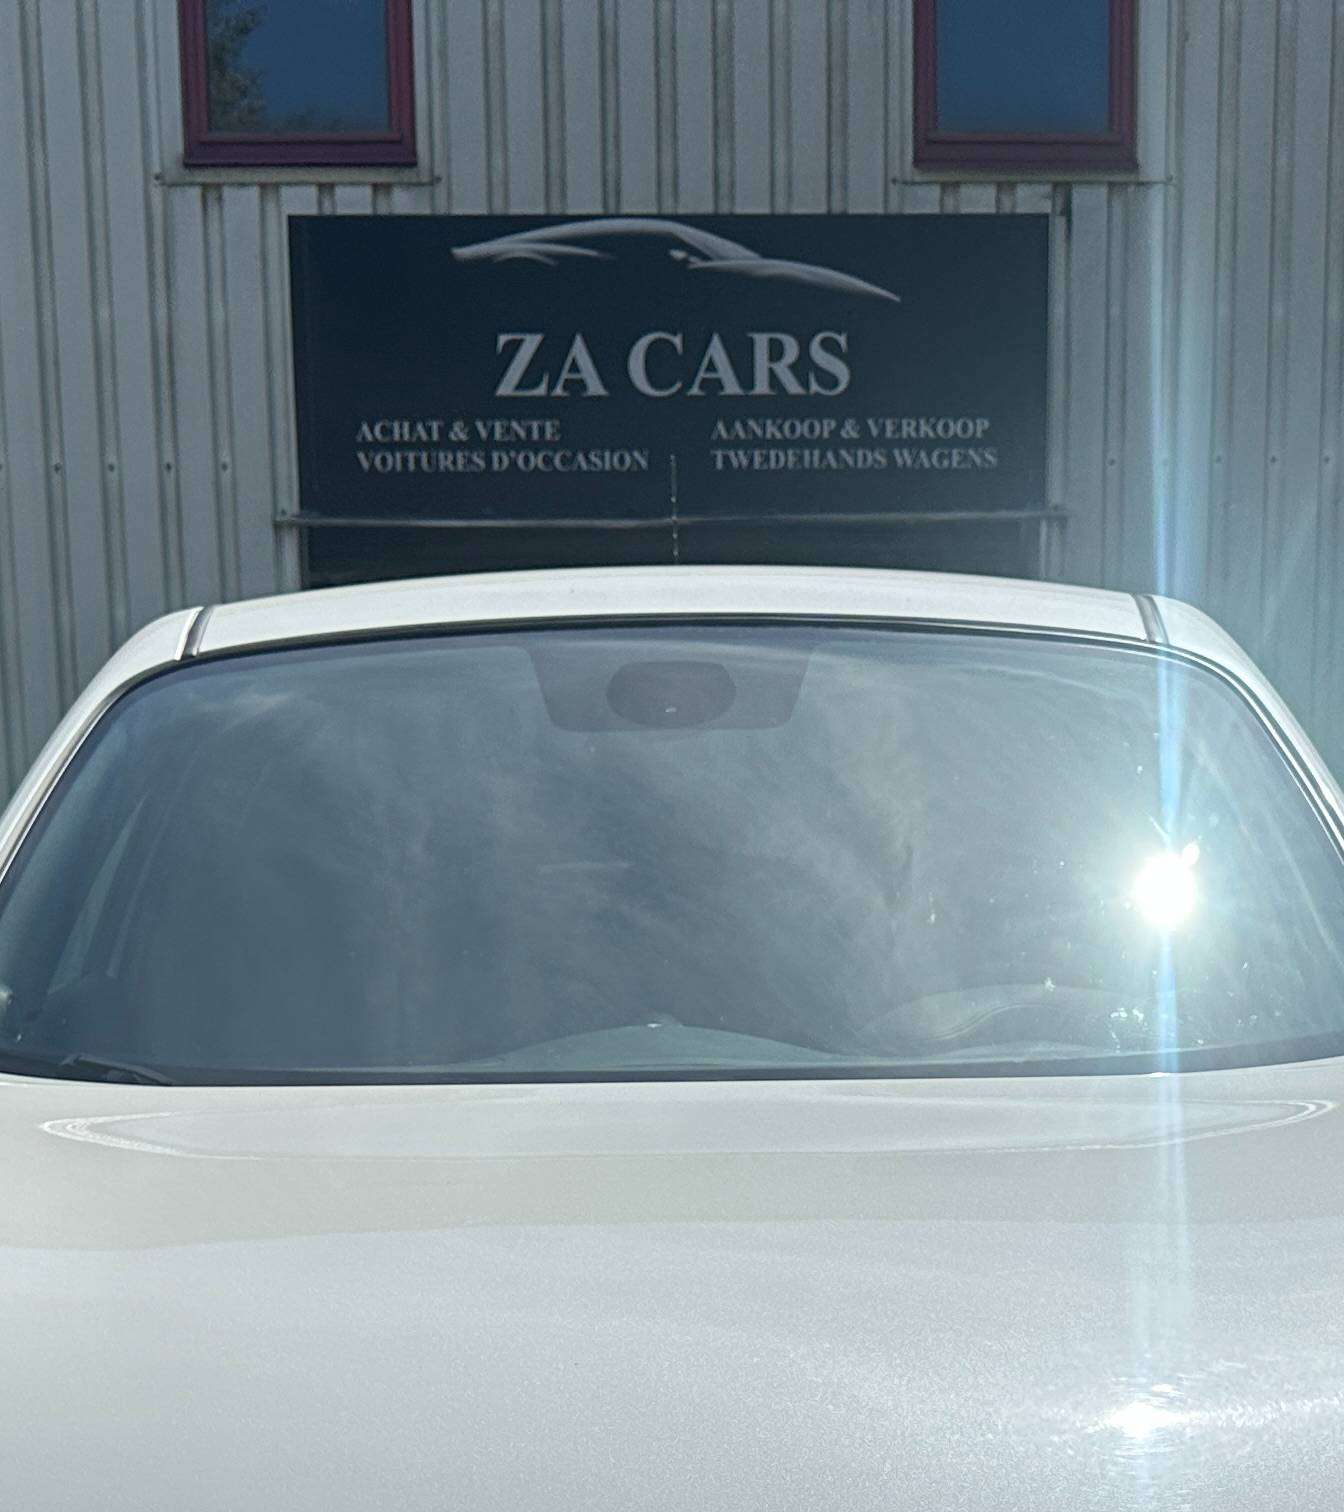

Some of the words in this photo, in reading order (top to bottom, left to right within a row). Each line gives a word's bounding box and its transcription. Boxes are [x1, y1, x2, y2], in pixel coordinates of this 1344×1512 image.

[495, 333, 608, 397] ZA
[627, 332, 851, 397] CARS
[356, 420, 444, 442] ACHAT
[448, 420, 470, 442] &
[475, 420, 561, 442] VENTE
[712, 419, 836, 440] AANKOOP
[840, 419, 860, 440] &
[867, 418, 990, 440] VERKOOP
[356, 450, 486, 472] VOITURES
[492, 450, 648, 472] D'OCCASION
[711, 449, 888, 470] TWEDEHANDS
[893, 448, 997, 469] WAGENS
